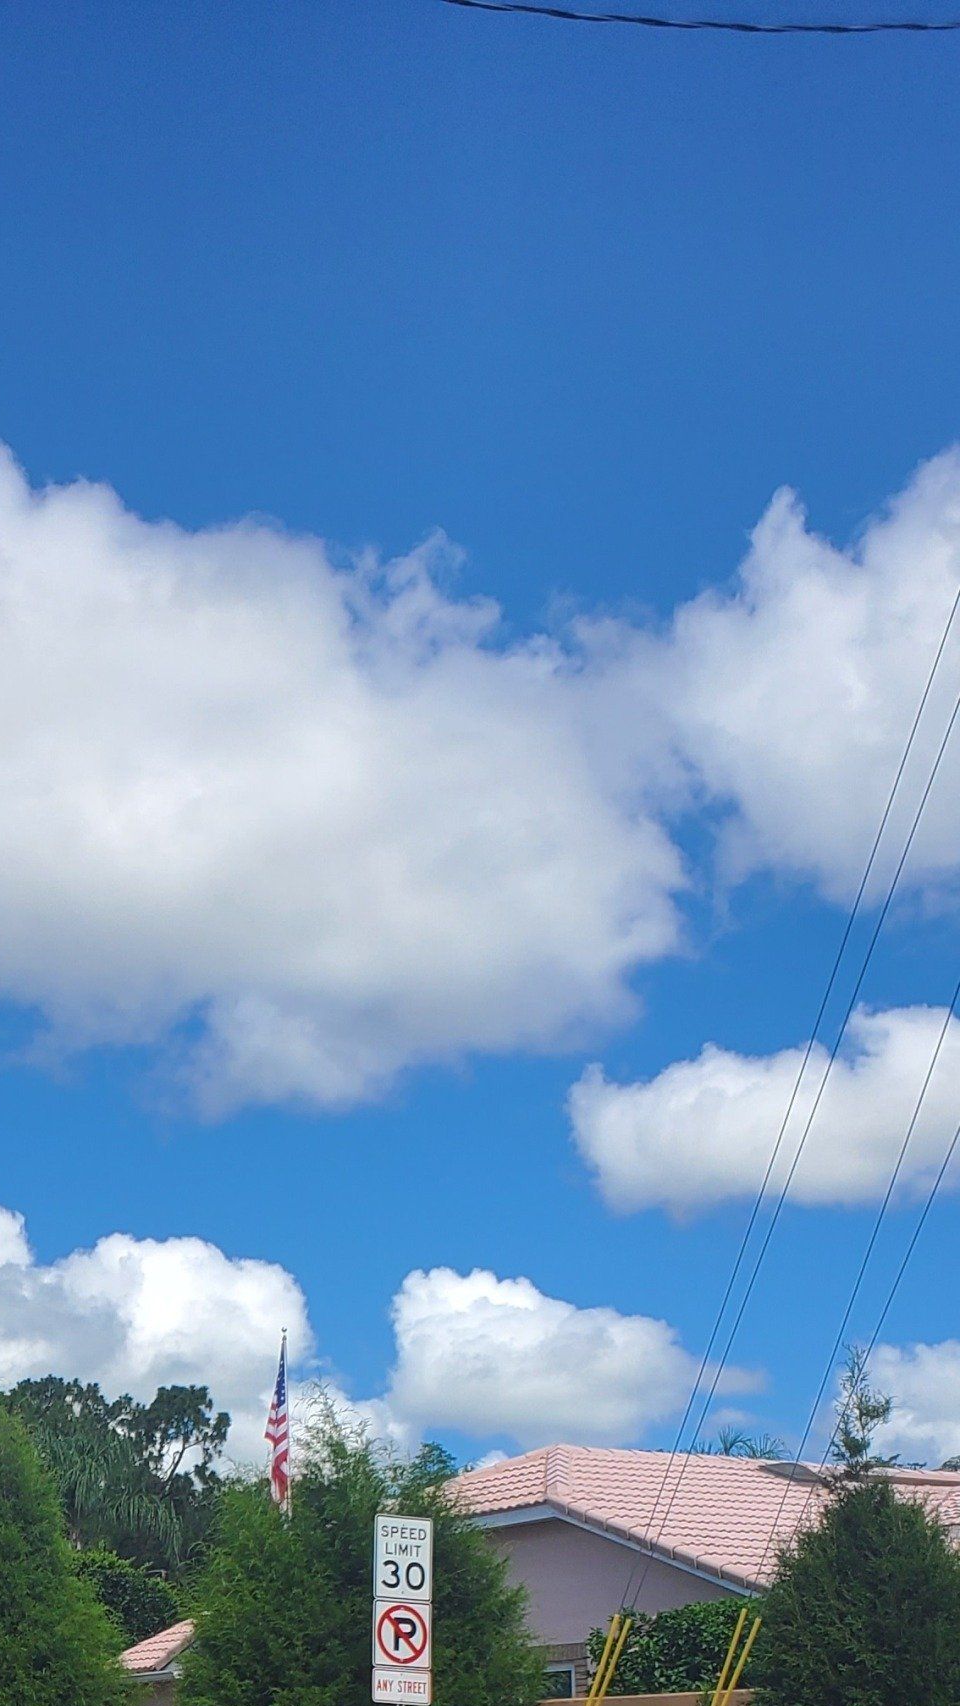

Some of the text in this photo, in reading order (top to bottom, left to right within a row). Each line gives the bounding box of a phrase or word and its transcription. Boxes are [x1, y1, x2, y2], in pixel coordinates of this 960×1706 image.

[380, 1525, 427, 1541] SPEED
[385, 1542, 422, 1557] LIMIT
[381, 1559, 426, 1591] 30
[393, 1617, 417, 1651] P
[376, 1679, 427, 1695] ANY STREET
